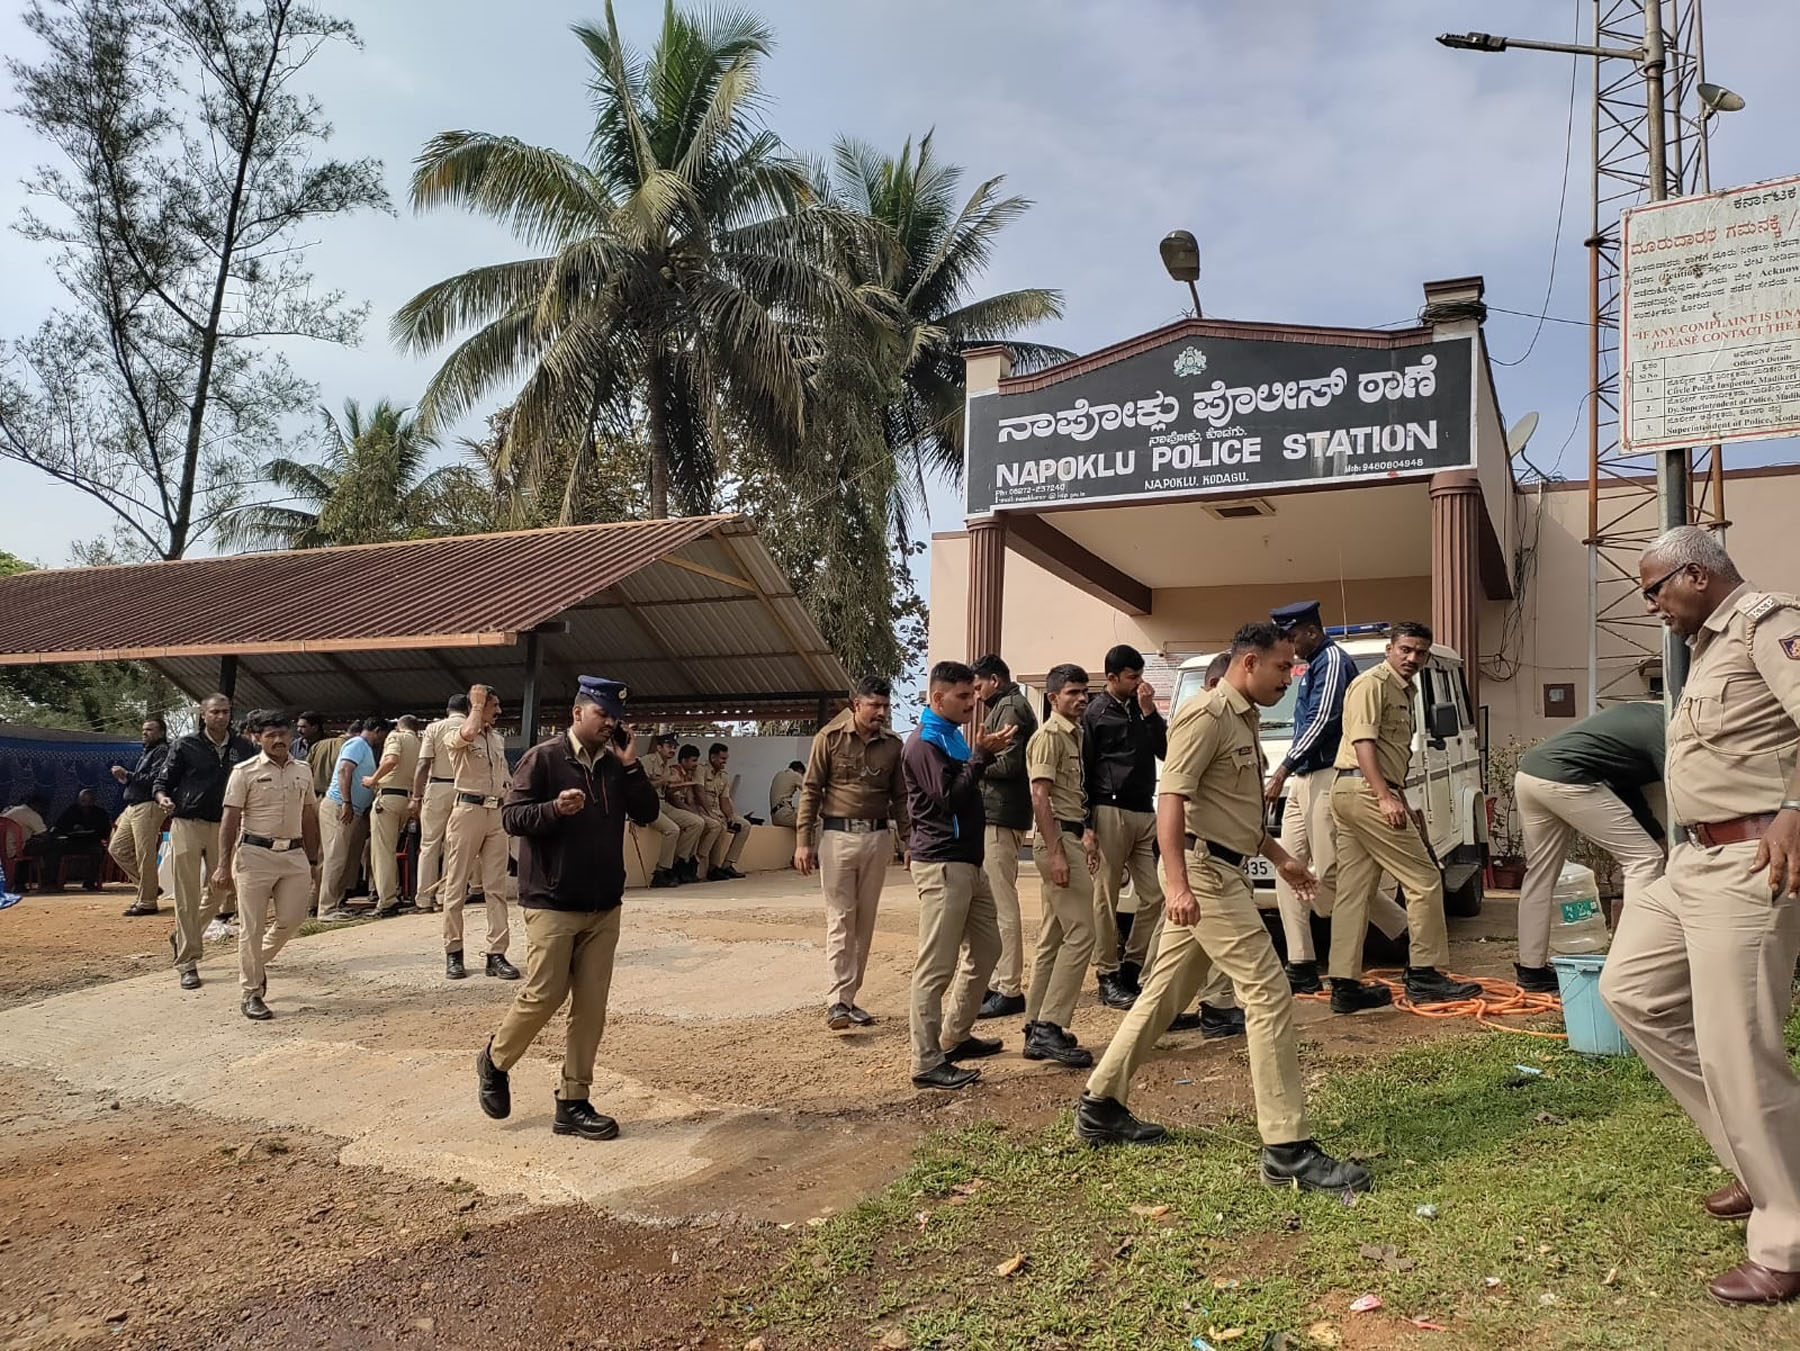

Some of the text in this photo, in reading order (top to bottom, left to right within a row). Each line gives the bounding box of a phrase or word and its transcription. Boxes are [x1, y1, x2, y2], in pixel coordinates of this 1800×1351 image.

[1734, 187, 1796, 209] ಕರ್ನಾಟಕ
[1652, 327, 1675, 338] ANY
[1680, 314, 1756, 333] COMPLAINT
[1760, 312, 1772, 322] IS
[1654, 335, 1699, 350] PLEASE
[1702, 326, 1763, 342] CONTACT
[1766, 322, 1794, 333] THE
[998, 354, 1438, 442] ನಾಪೋಕ್ಲು ಪೊಲೀಸ್ ಠಾಣೆ
[1666, 422, 1731, 434] Superintendent
[996, 420, 1438, 488] NAPOKLU POLICE STATION
